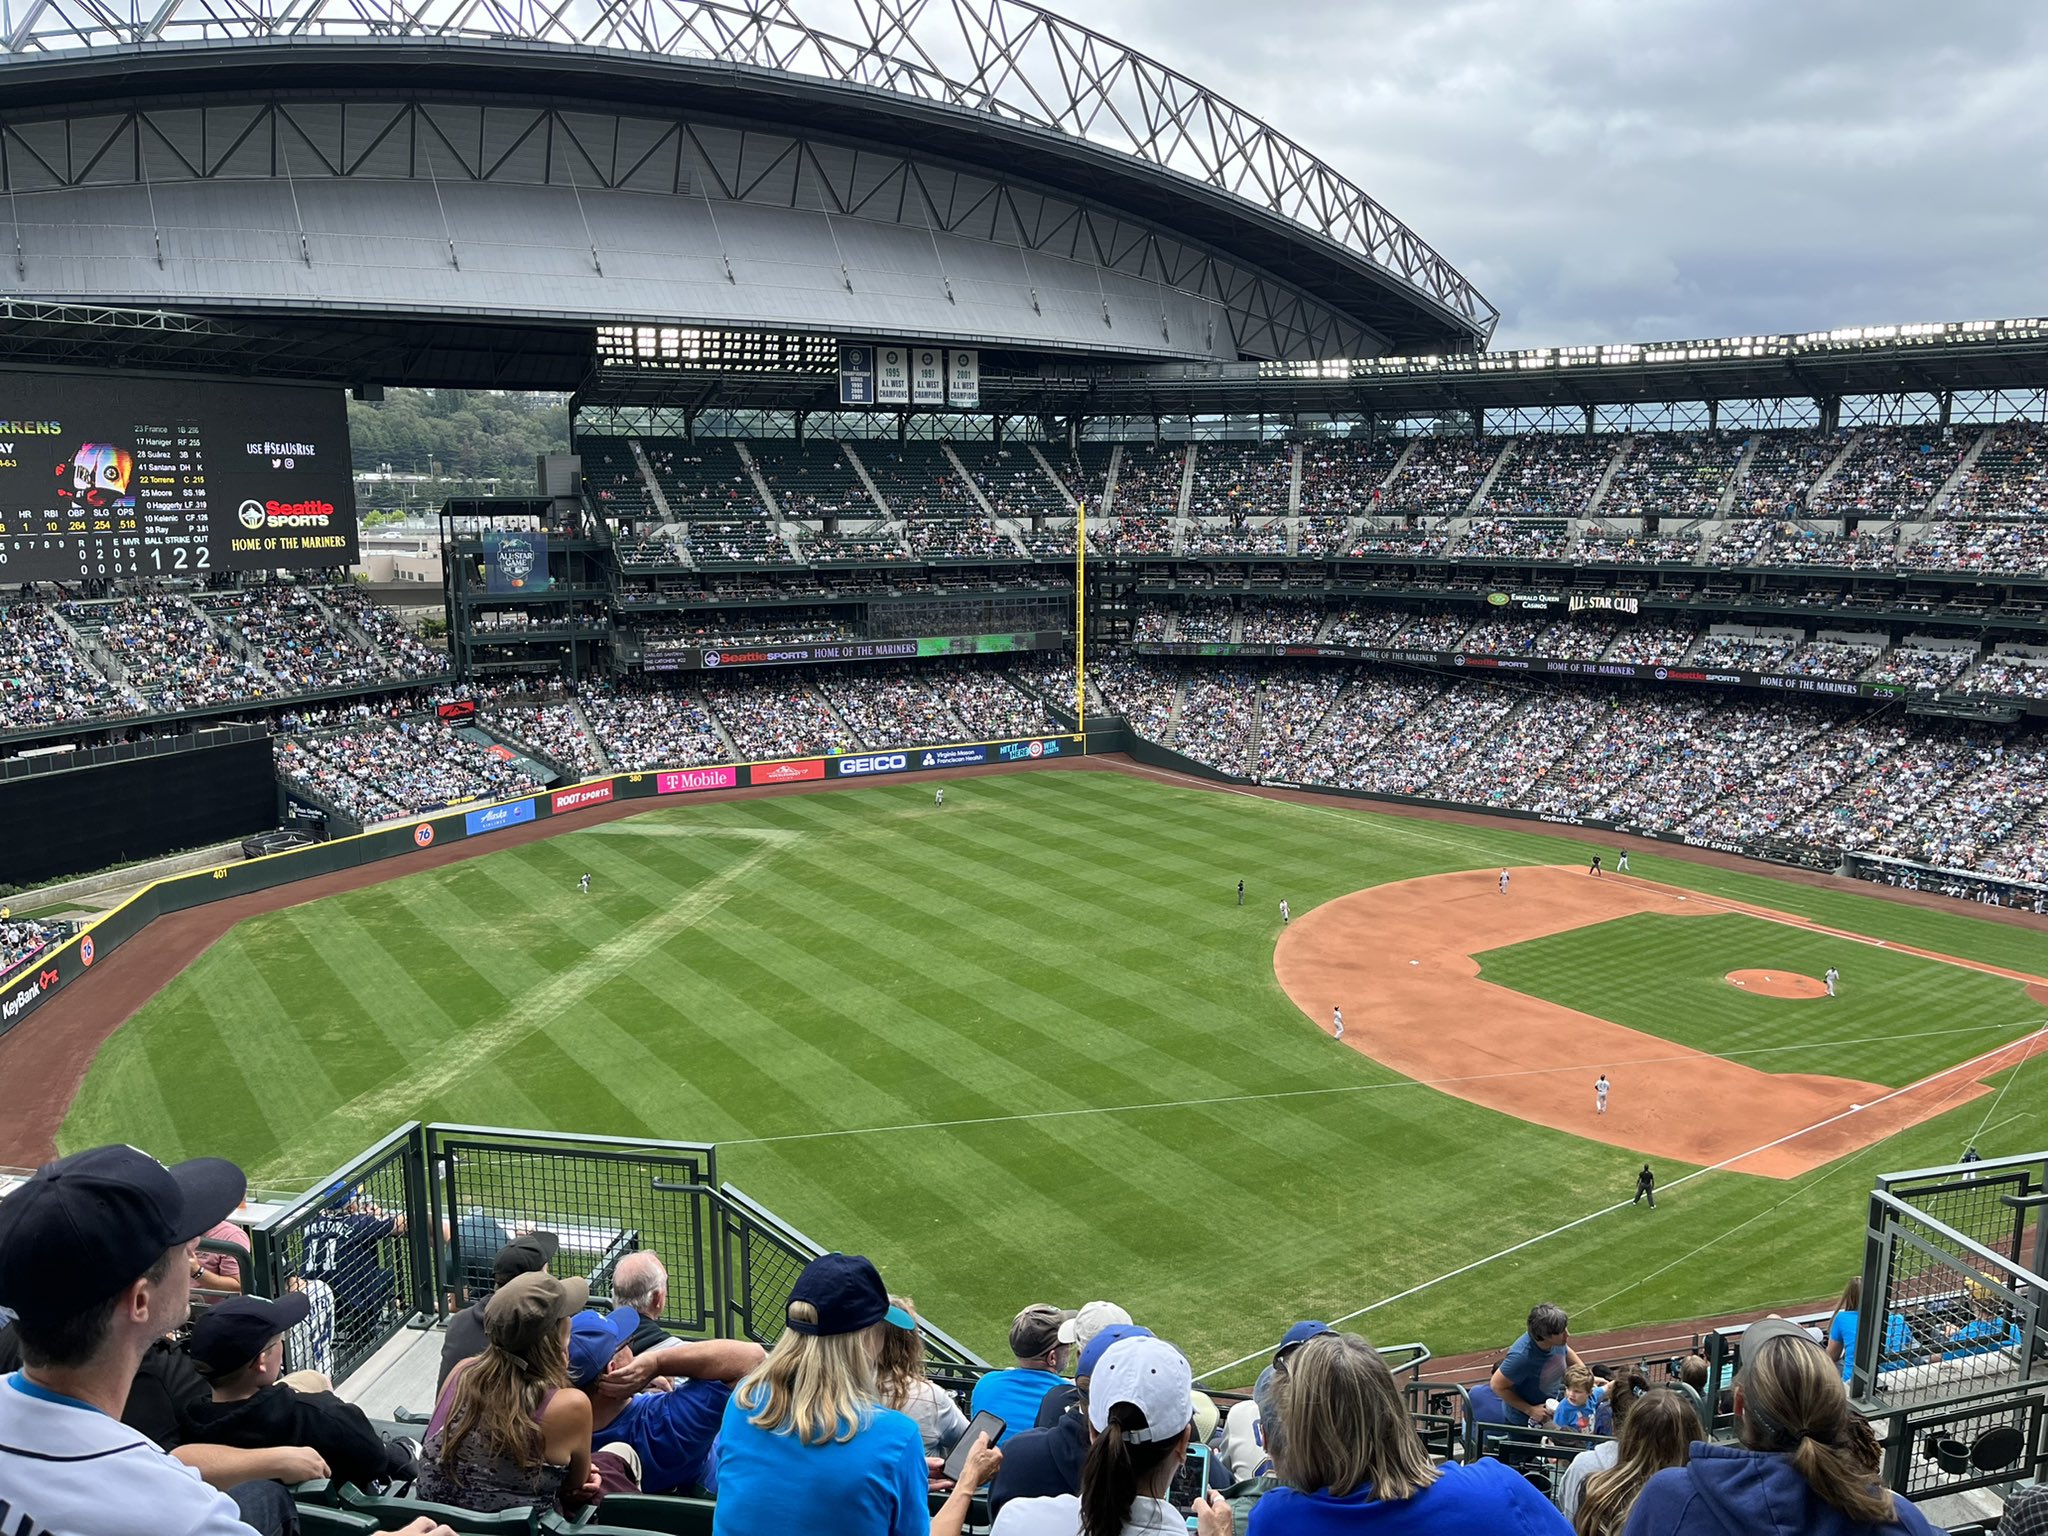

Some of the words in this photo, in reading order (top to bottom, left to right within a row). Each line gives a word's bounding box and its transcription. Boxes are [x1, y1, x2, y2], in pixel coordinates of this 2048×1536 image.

[886, 368, 900, 377] 1995
[921, 369, 935, 378] 1997
[957, 370, 971, 379] 2001
[890, 380, 904, 388] WEST
[926, 381, 940, 389] WEST
[962, 382, 975, 390] WEST
[879, 390, 908, 398] CHAMPIONS
[915, 391, 942, 399] CHAMPIONS
[950, 392, 977, 400] CHAMPIONS
[144, 425, 168, 433] France
[146, 438, 172, 447] Haniger
[246, 443, 262, 454] USE
[195, 451, 202, 459] K
[150, 476, 175, 484] Torrens
[183, 476, 190, 484] C
[141, 489, 150, 497] 25
[151, 489, 173, 497] Moore
[152, 502, 183, 510] Haggerty
[184, 501, 194, 509] LF
[266, 500, 334, 515] Seattle
[19, 510, 33, 519] HR
[43, 509, 59, 518] RBI
[67, 509, 86, 517] OBP
[93, 508, 110, 517] SLG
[117, 508, 135, 516] OPS
[153, 514, 179, 522] Kelenic
[46, 522, 58, 531] 10
[67, 521, 86, 531] .264
[92, 520, 111, 530] .254
[118, 520, 136, 529] .518
[267, 515, 330, 528] SPORTS
[145, 526, 154, 534] 38
[155, 526, 169, 535] Ray
[14, 542, 20, 550] 6
[29, 541, 35, 550] 7
[43, 540, 50, 549] 8
[58, 540, 65, 548] 9
[78, 539, 85, 547] R
[95, 539, 103, 547] H
[113, 538, 120, 546] E
[122, 537, 141, 546] MVR
[144, 537, 163, 545] BALL
[164, 536, 191, 544] STRIKE
[193, 535, 209, 543] OUT
[231, 539, 261, 551] HOME
[264, 538, 277, 550] OF
[280, 537, 299, 549] THE
[301, 536, 346, 549] MARINERS
[0, 553, 8, 564] 0
[79, 549, 87, 560] 0
[96, 549, 104, 559] 2
[113, 548, 121, 558] 0
[129, 548, 136, 558] 5
[151, 548, 161, 570] 1
[173, 547, 189, 569] 2
[196, 546, 211, 568] 2
[80, 564, 88, 575] 0
[98, 563, 106, 574] 0
[114, 563, 122, 573] 0
[130, 562, 138, 572] 4
[1614, 597, 1638, 614] CLUB
[720, 651, 768, 663] Seattle
[767, 650, 808, 661] SPORTS
[815, 648, 840, 659] HOME
[842, 646, 854, 657] OF
[857, 645, 873, 656] THE
[875, 643, 917, 655] MARINERS
[1361, 650, 1380, 659] HOME
[1381, 651, 1390, 659] OF
[1392, 652, 1404, 660] THE
[1405, 653, 1438, 662] MARINERS
[1498, 660, 1529, 669] SPORTS
[1547, 661, 1569, 672] HOME
[1570, 662, 1581, 672] OF
[1582, 663, 1597, 673] THE
[1598, 664, 1635, 676] MARINERS
[1706, 674, 1741, 683] SPORTS
[1760, 676, 1784, 688] HOME
[1785, 677, 1798, 688] OF
[1799, 679, 1815, 691] THE
[1816, 681, 1857, 695] MARINERS
[1873, 687, 1894, 698] 2:35
[1000, 745, 1011, 755] HIT
[1011, 743, 1019, 752] IT
[1043, 740, 1056, 749] WIN
[936, 751, 957, 759] Virginia
[1010, 747, 1030, 760] HERE
[839, 754, 907, 774] GEICO
[629, 774, 642, 782] 380
[681, 771, 727, 788] Mobile
[556, 792, 581, 808] ROOT
[581, 787, 610, 801] SPORTS
[480, 808, 508, 823] Alaska
[418, 828, 430, 841] 76
[1684, 835, 1711, 848] ROOT
[1710, 841, 1744, 853] SPORTS
[213, 868, 228, 879] 401
[2, 981, 41, 1020] KeyBank
[305, 1238, 337, 1273] 11
